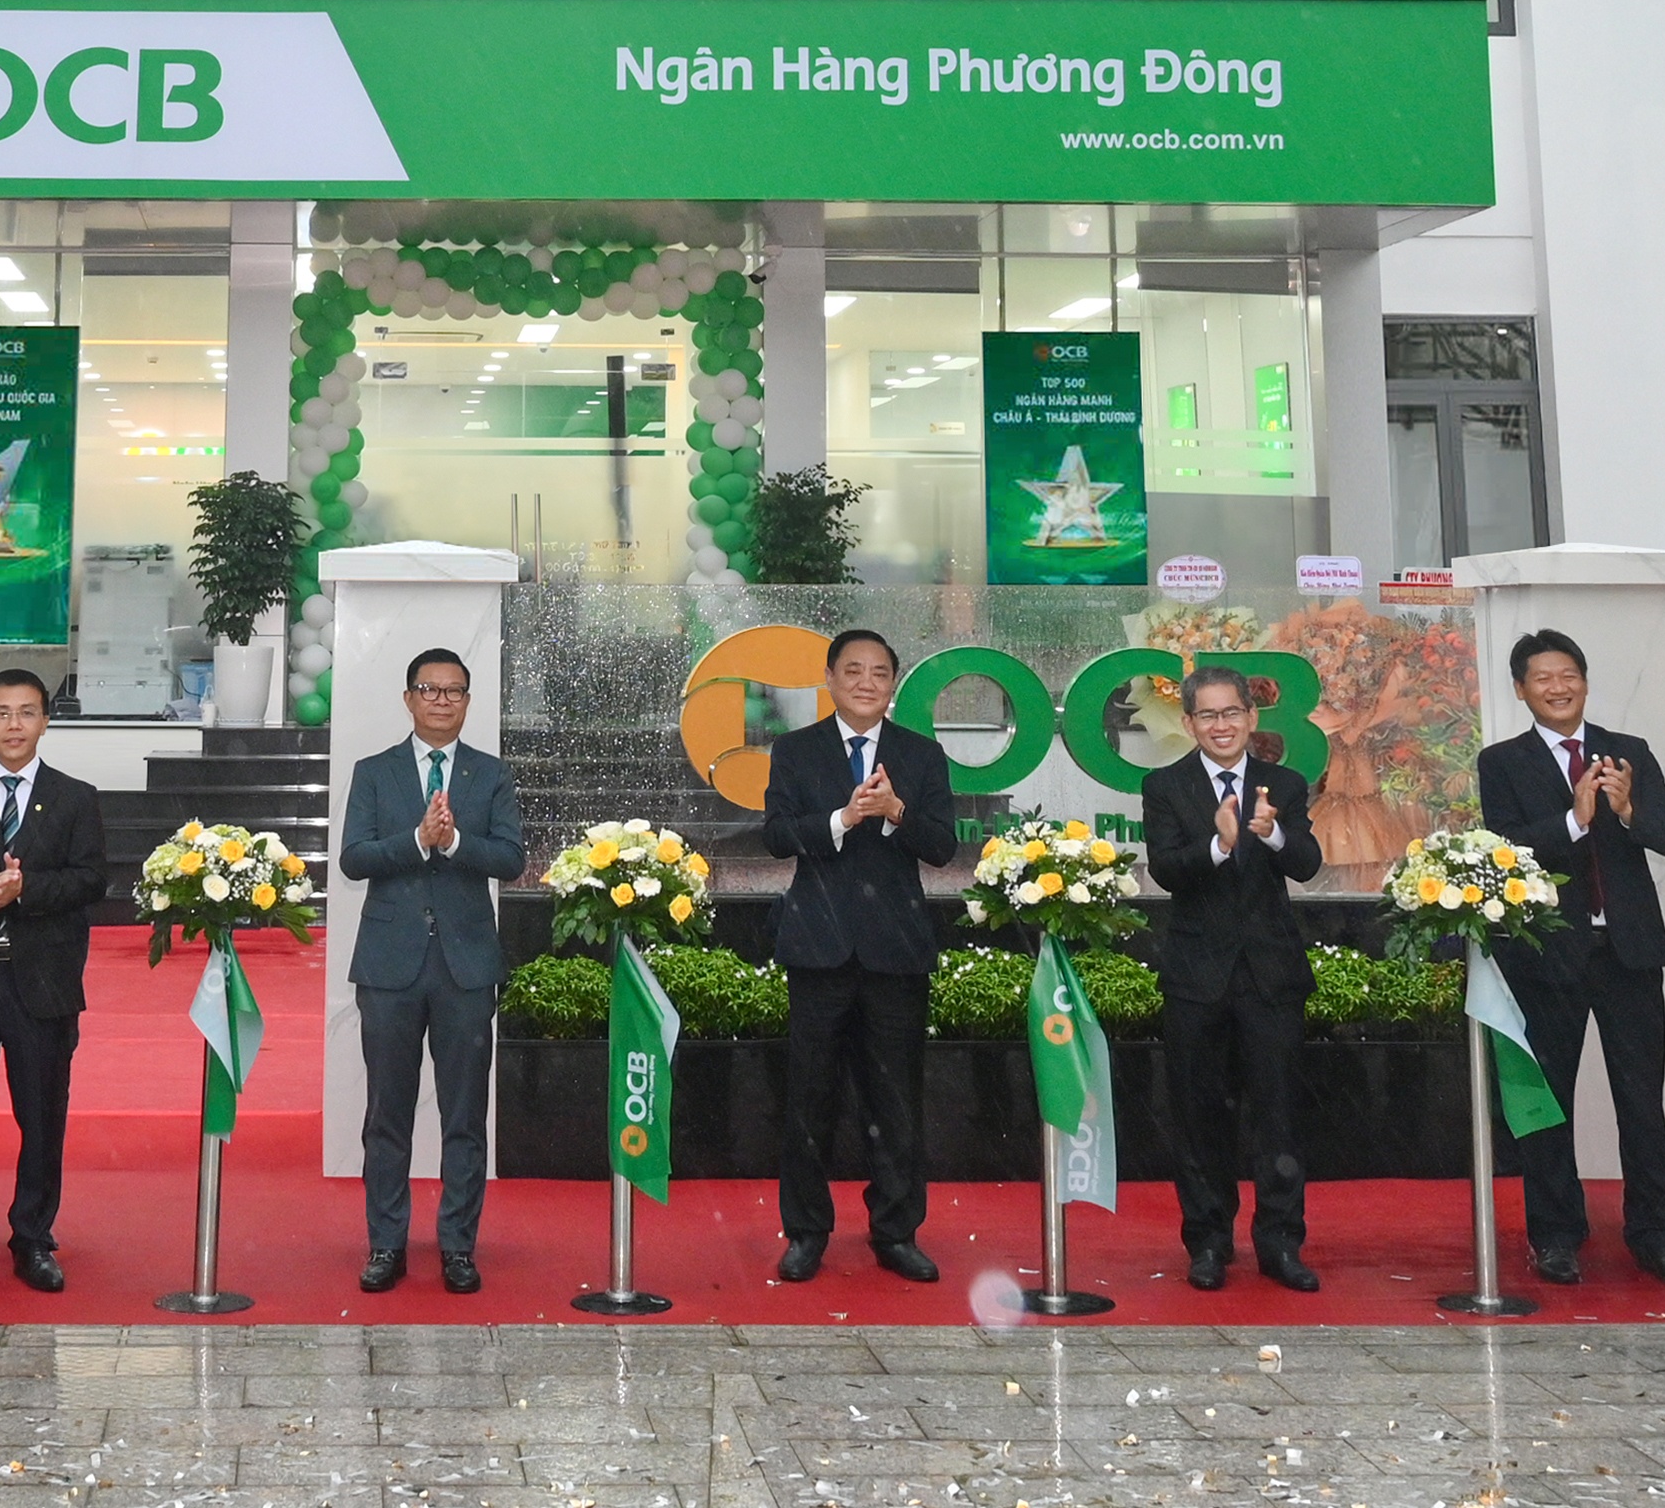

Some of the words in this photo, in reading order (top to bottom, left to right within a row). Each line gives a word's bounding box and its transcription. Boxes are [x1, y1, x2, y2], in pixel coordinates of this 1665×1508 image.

[615, 46, 753, 106] Ngân
[771, 46, 908, 106] Hàng
[929, 48, 1125, 107] Phương
[1140, 48, 1283, 108] Đông
[1060, 129, 1284, 152] www.ocb.com.vn
[1052, 346, 1088, 358] OCB
[1041, 377, 1060, 388] TOP
[1064, 377, 1085, 388] 500
[38, 392, 55, 404] GIA
[894, 646, 1329, 795] OCB
[624, 1050, 648, 1122] OCB
